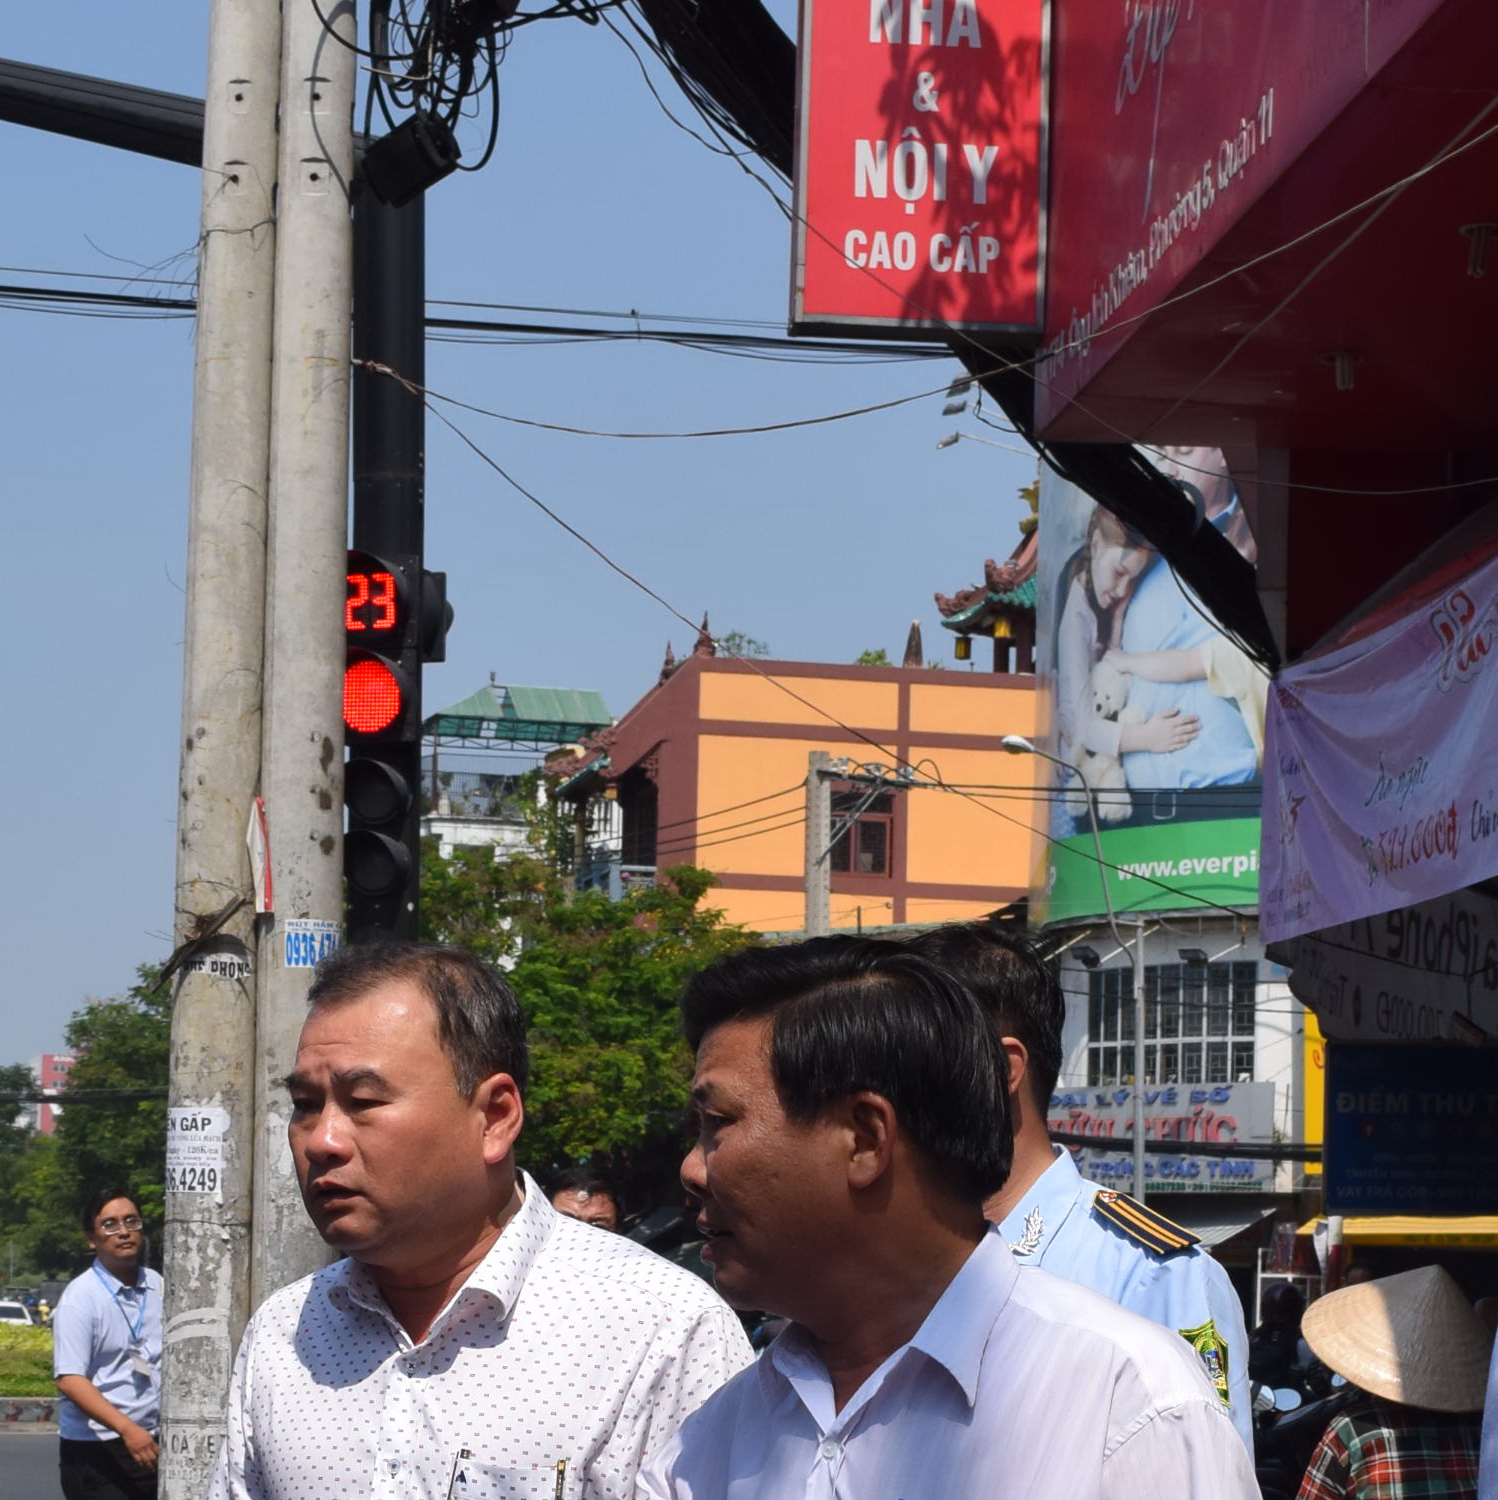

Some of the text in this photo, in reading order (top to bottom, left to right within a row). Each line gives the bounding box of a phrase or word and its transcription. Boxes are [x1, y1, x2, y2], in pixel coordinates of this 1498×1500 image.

[913, 72, 940, 112] &
[1218, 118, 1256, 190] Quận
[1257, 87, 1274, 147] 11
[854, 126, 999, 215] NỘI Y
[844, 222, 1001, 274] CAO CẤP
[345, 572, 396, 631] 23
[1117, 849, 1260, 881] www.everpi
[286, 931, 316, 966] 0936
[1095, 1088, 1130, 1107] LÝ
[1336, 1084, 1409, 1114] ĐIỂM
[1416, 1091, 1476, 1115] THU
[180, 1111, 212, 1132] GẤP
[167, 1167, 217, 1191] 6.4249
